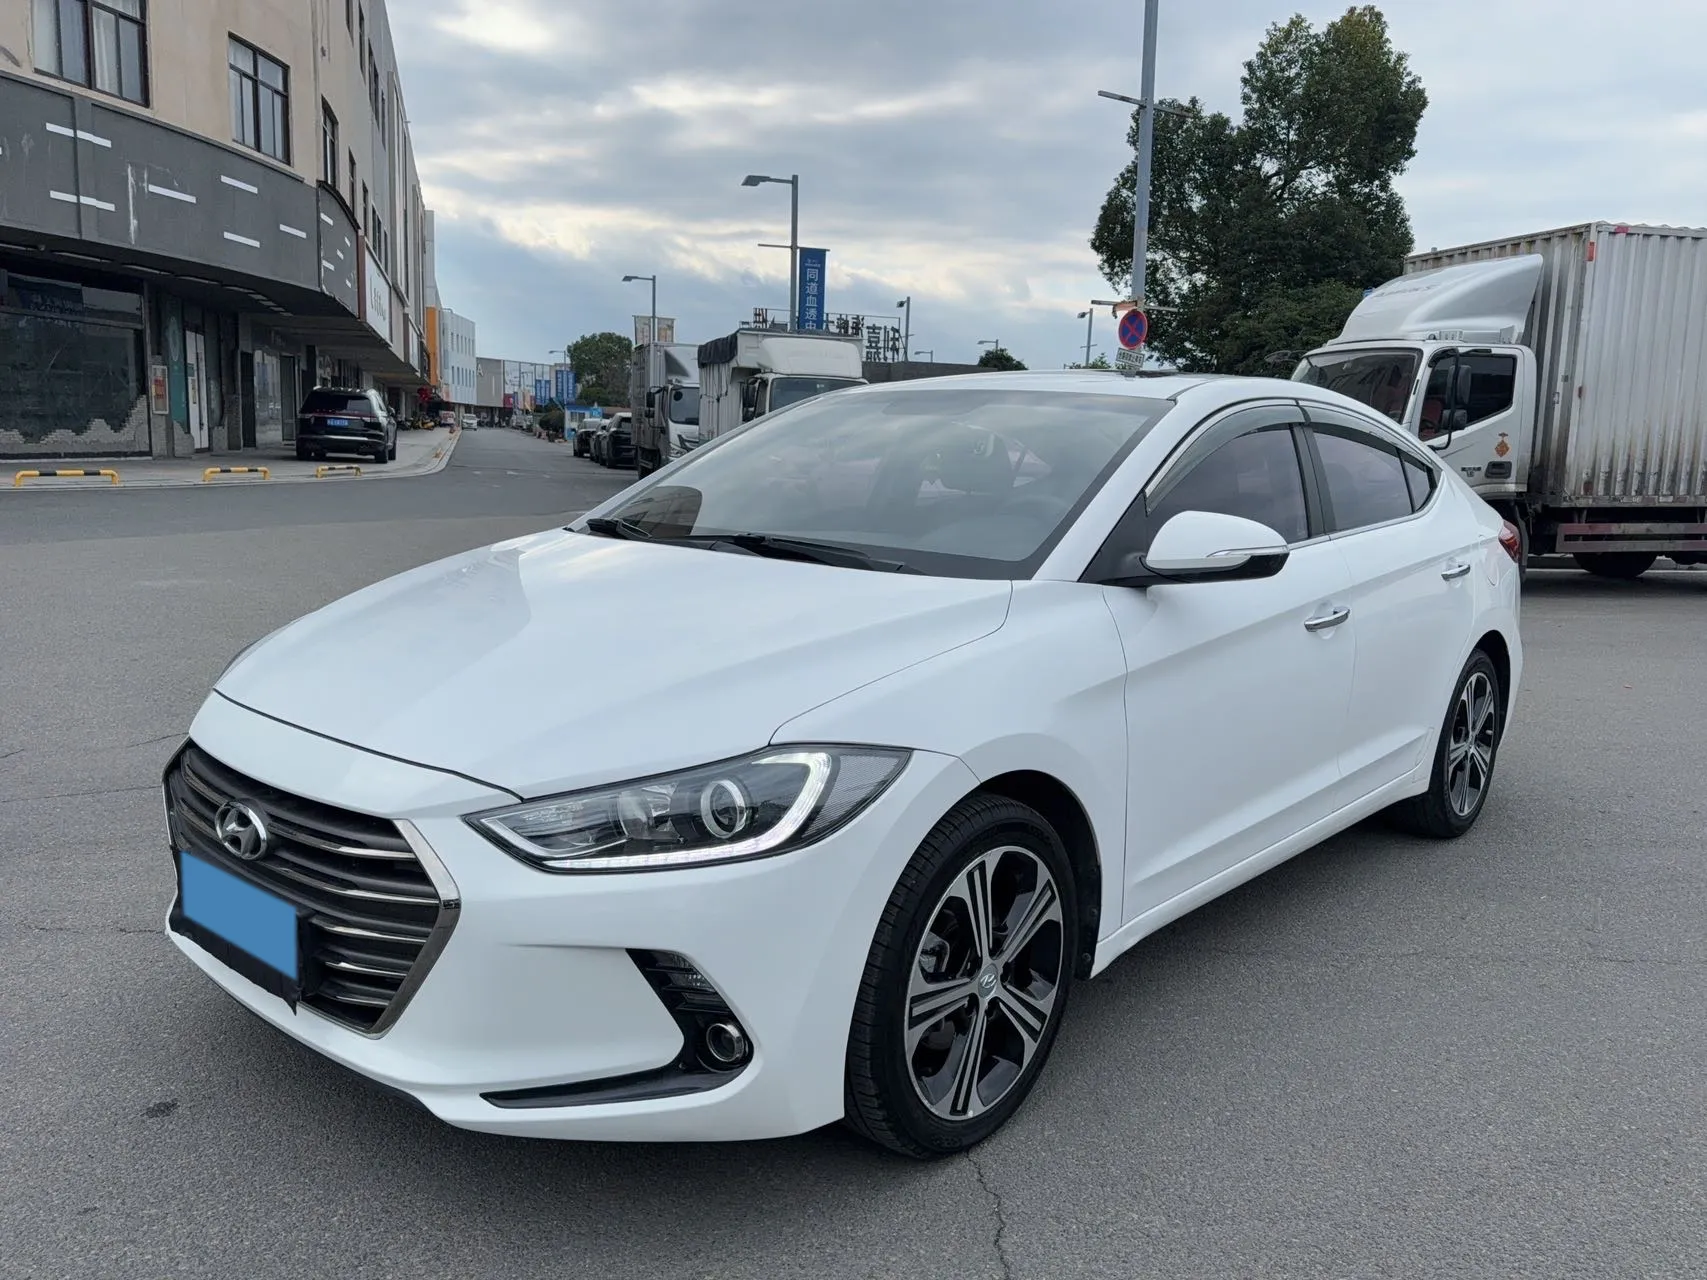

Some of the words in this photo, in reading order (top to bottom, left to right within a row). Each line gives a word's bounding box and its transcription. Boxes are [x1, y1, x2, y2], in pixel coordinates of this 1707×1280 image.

[805, 268, 819, 330] 同道血透中
